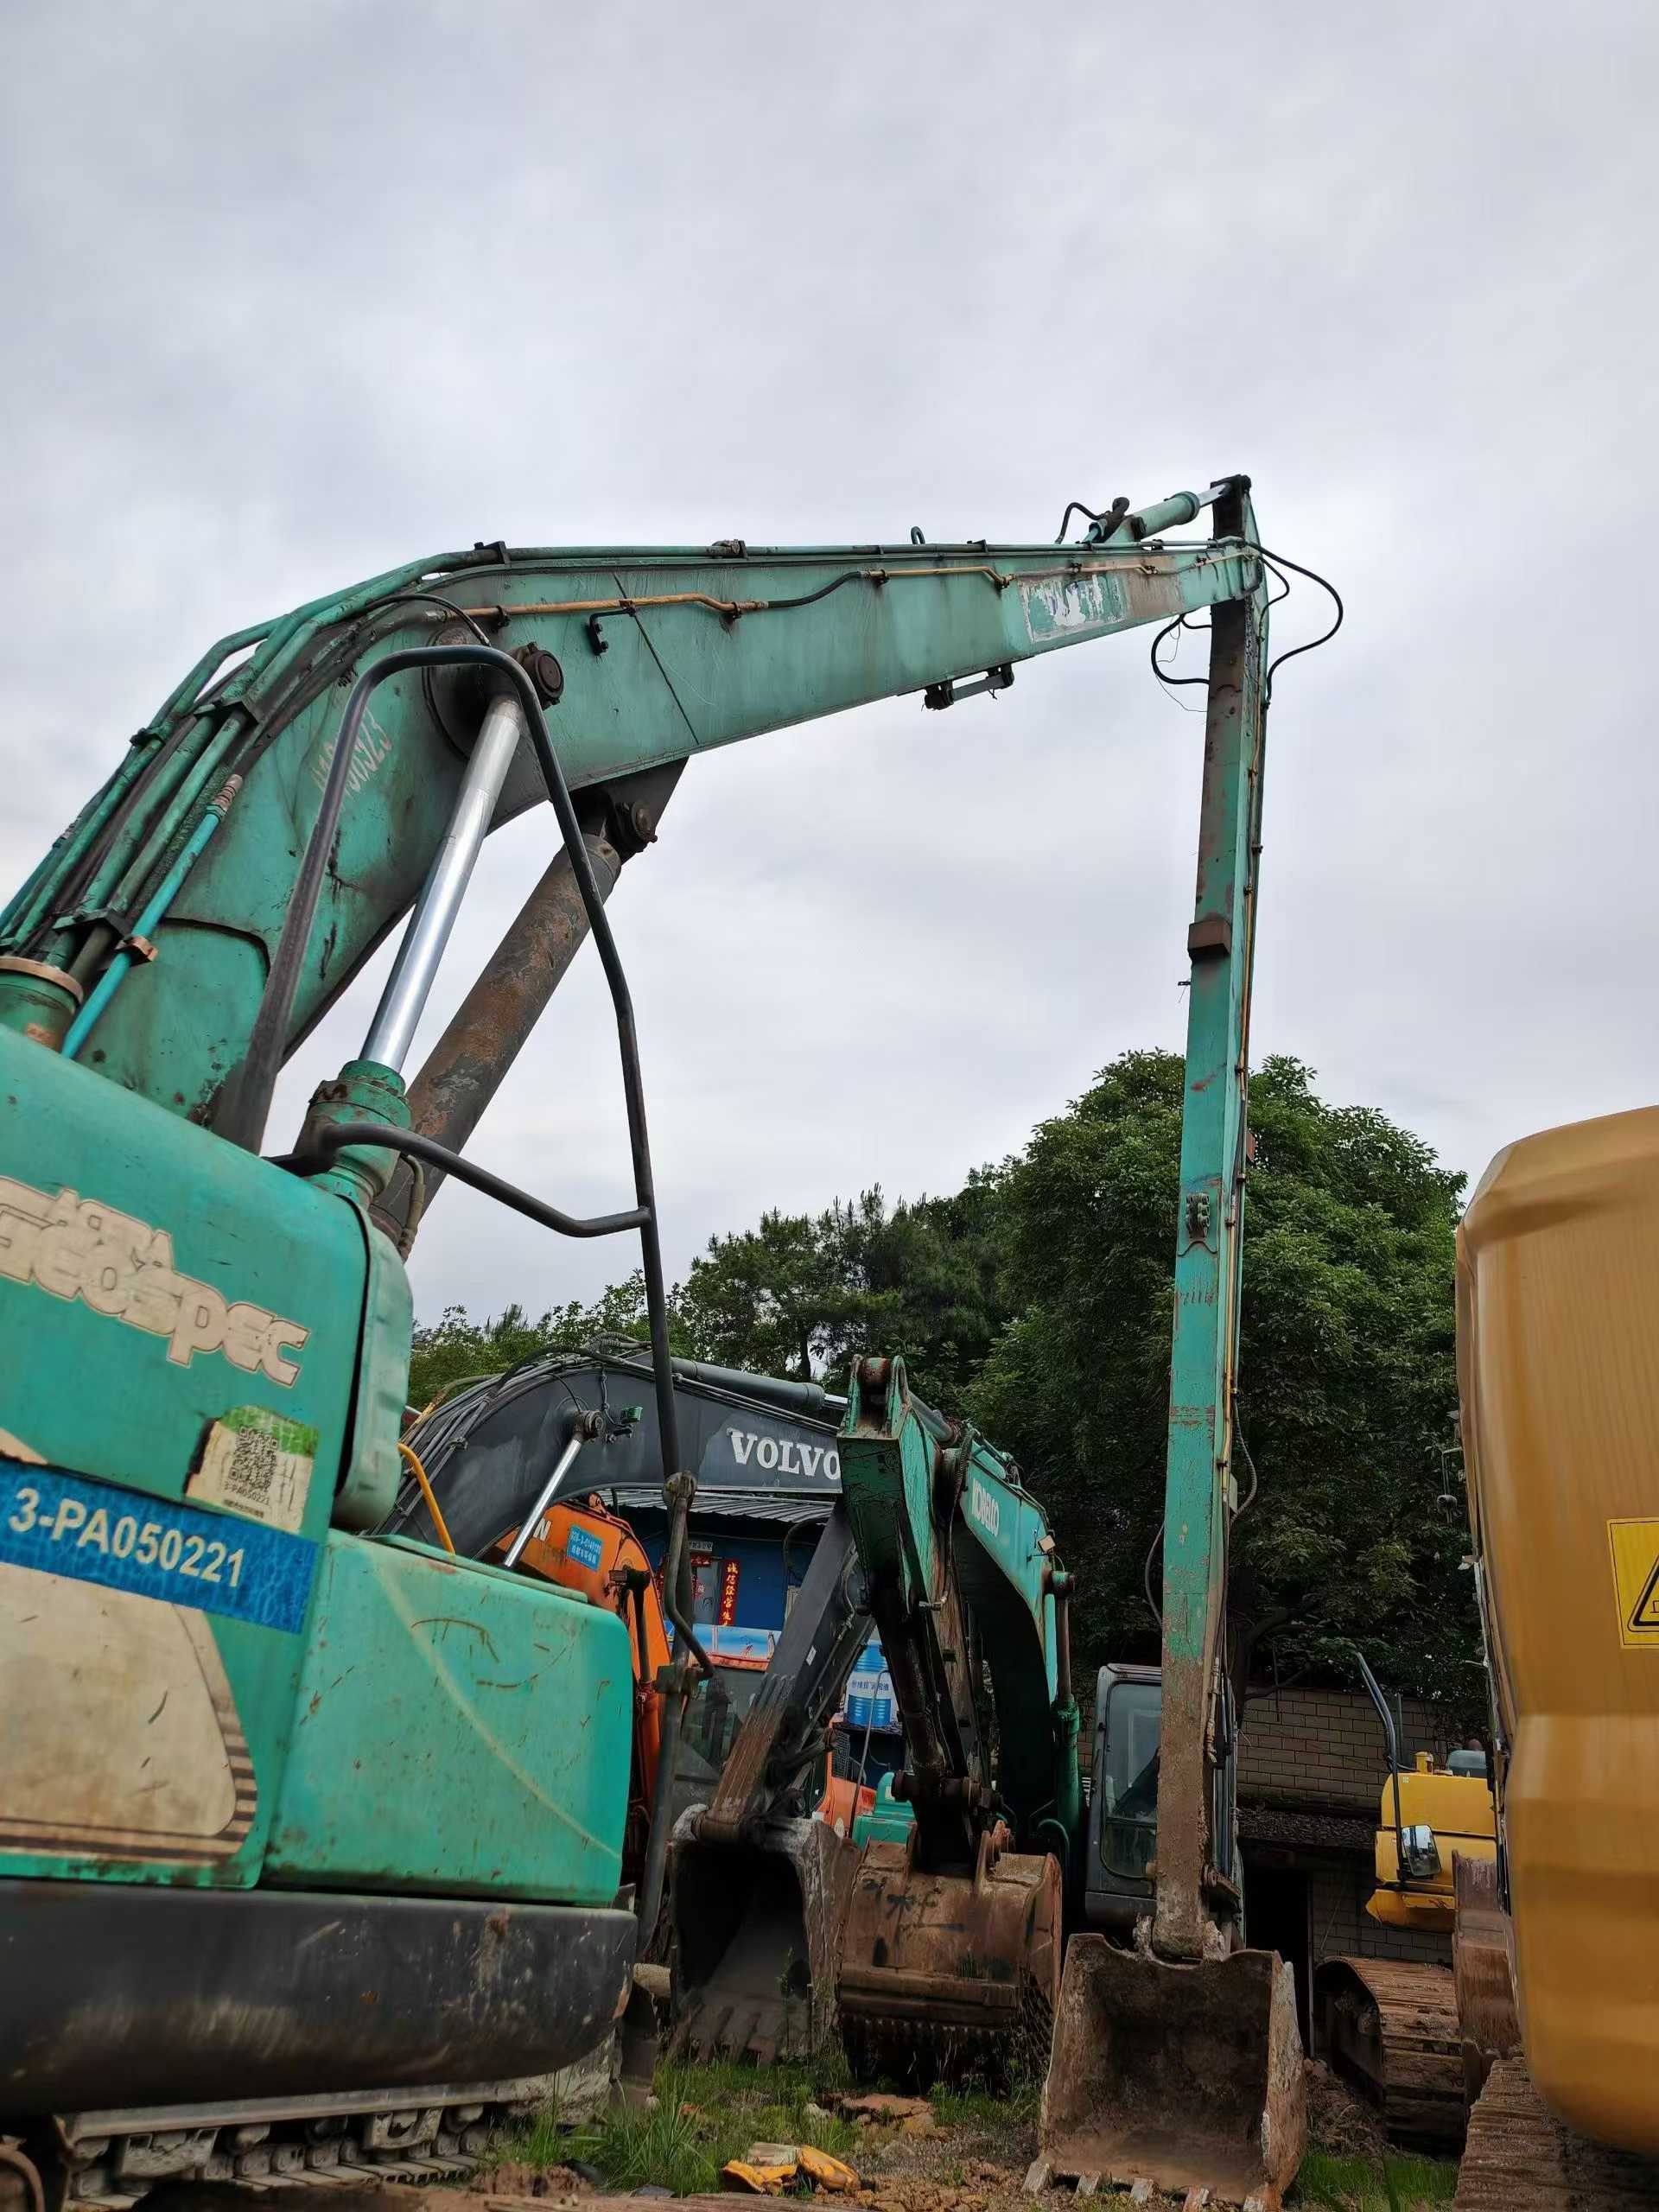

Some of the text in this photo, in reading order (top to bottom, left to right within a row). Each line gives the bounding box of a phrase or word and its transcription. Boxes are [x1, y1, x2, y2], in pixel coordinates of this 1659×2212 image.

[727, 1427, 842, 1480] VOLVO
[972, 1478, 1000, 1537] KOBELCO
[9, 1487, 245, 1588] 3-PA050221
